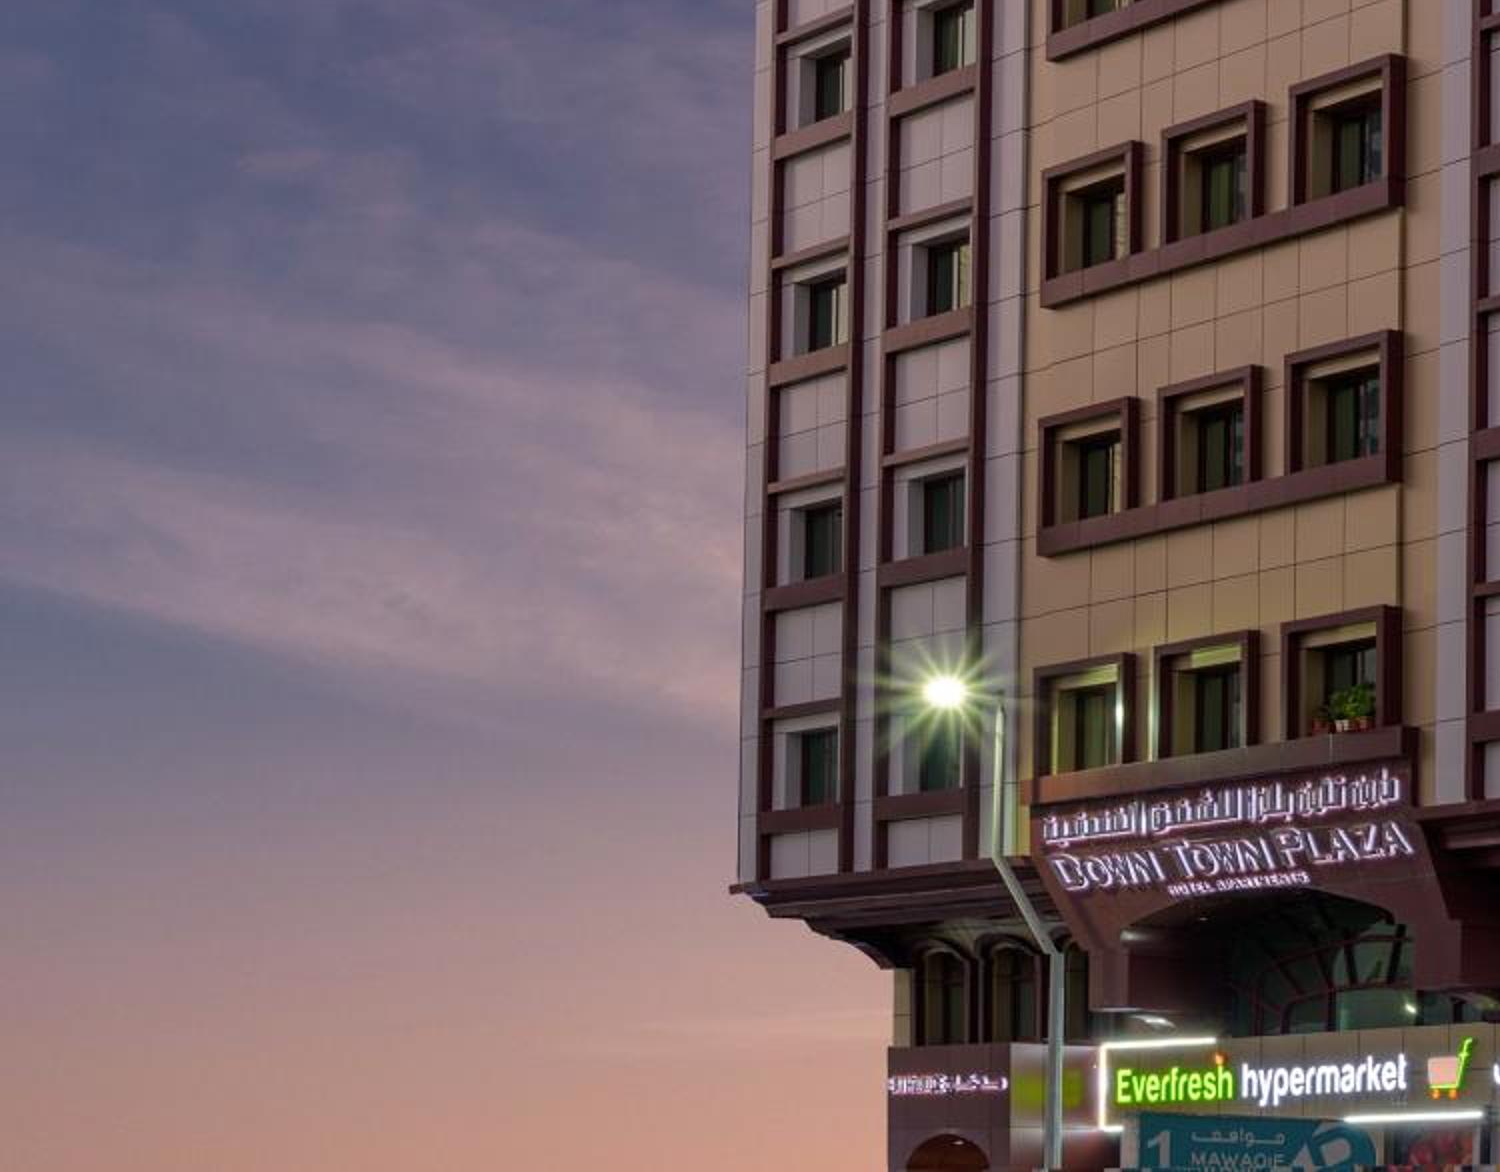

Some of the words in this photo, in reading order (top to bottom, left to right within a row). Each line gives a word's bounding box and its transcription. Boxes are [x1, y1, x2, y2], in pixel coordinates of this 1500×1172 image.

[1050, 849, 1166, 891] DOWN
[1164, 839, 1277, 880] TOWN
[1271, 820, 1414, 867] PLAZA
[1116, 1065, 1234, 1104] Everfresh
[1241, 1053, 1407, 1106] hypermarket
[1149, 1130, 1171, 1169] 1
